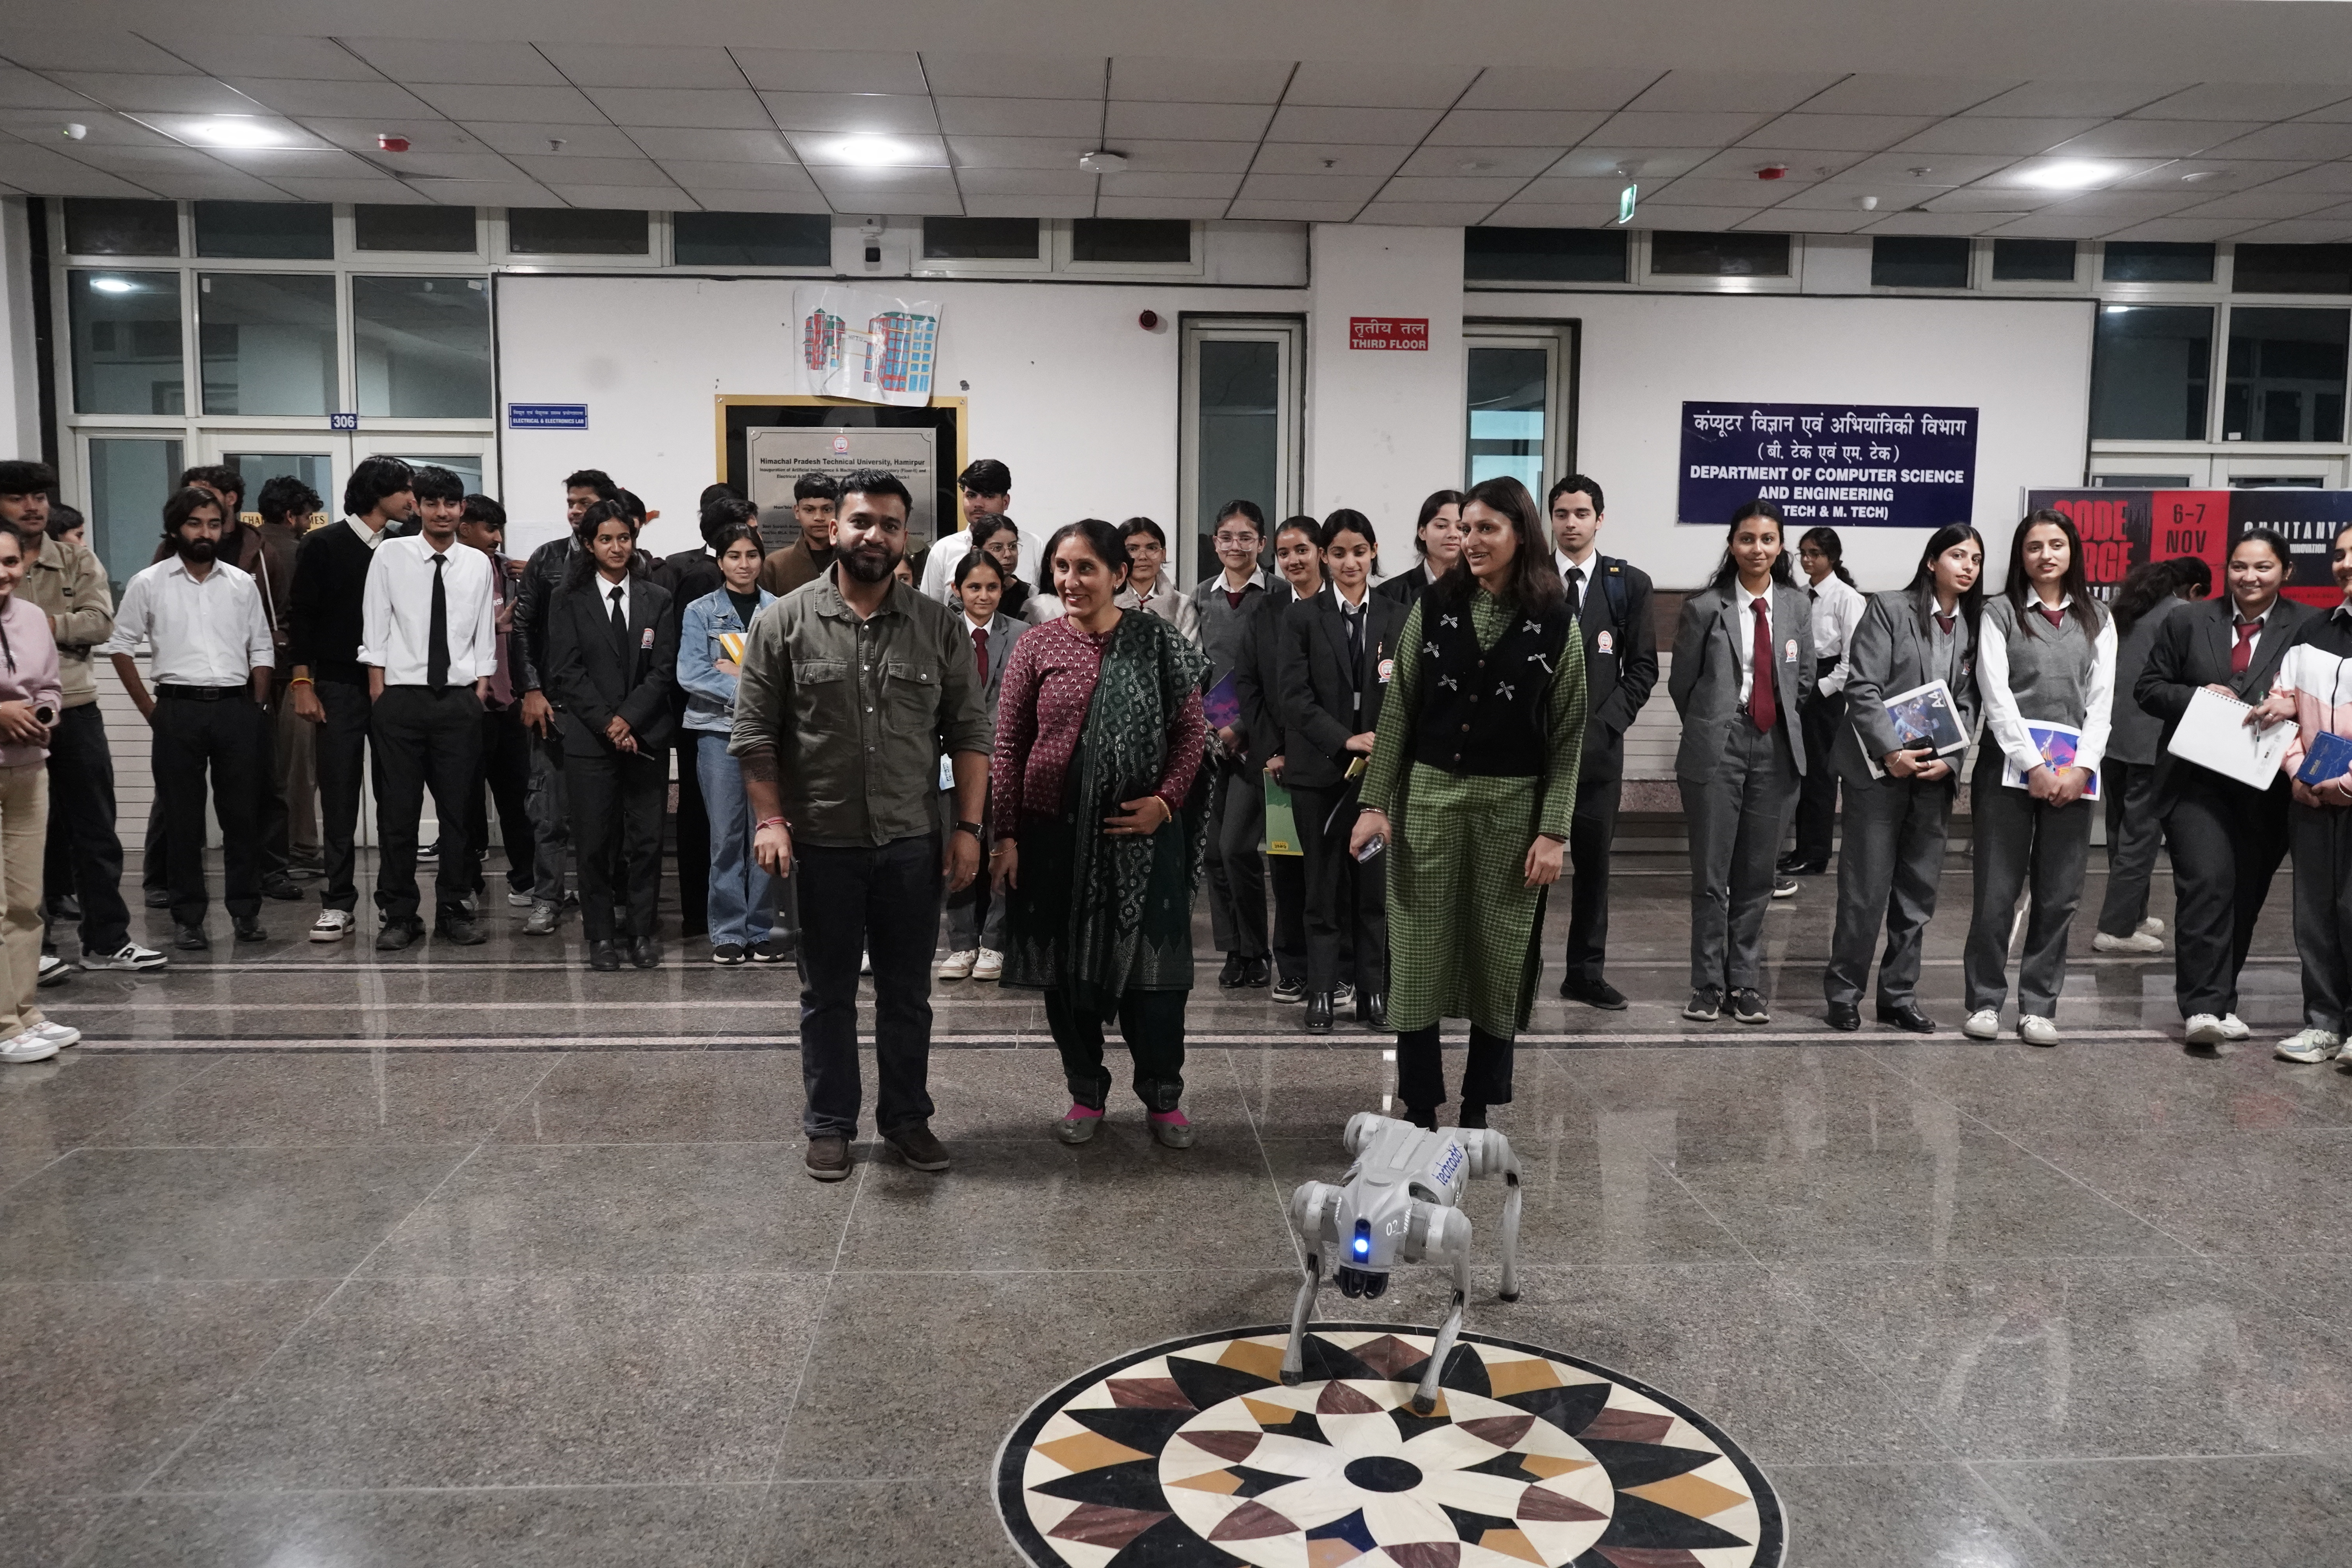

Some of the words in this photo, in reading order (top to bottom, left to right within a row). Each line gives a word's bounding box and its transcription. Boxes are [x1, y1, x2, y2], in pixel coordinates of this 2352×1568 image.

[1353, 319, 1393, 338] तृतीय
[1399, 323, 1426, 334] तल
[1352, 339, 1386, 348] THIRD
[1390, 339, 1426, 349] FLOOR
[334, 415, 355, 428] 306
[1693, 410, 1744, 437] कंप्यूटर
[1750, 410, 1795, 435] विज्ञान
[1800, 412, 1824, 438] एवं
[1830, 412, 1915, 435] अभियांत्रिकी
[1921, 413, 1967, 436] विभाग
[1790, 439, 1813, 459] टेक
[1817, 442, 1837, 464] एवं
[1842, 446, 1862, 464] एम.
[1690, 465, 1788, 480] DEPARTMENT
[1792, 467, 1812, 481] OF
[1815, 467, 1896, 482] COMPUTER
[1900, 469, 1964, 483] SCIENCE
[1758, 486, 1789, 499] AND
[1793, 486, 1894, 501] ENGINEERING
[1782, 505, 1816, 517] TECH
[1819, 506, 1829, 517] &
[1833, 506, 1847, 517] M.
[1850, 506, 1889, 521] TECH)
[2173, 504, 2205, 524] 6-7
[2166, 530, 2207, 554] NOV
[1928, 691, 1944, 707] A4
